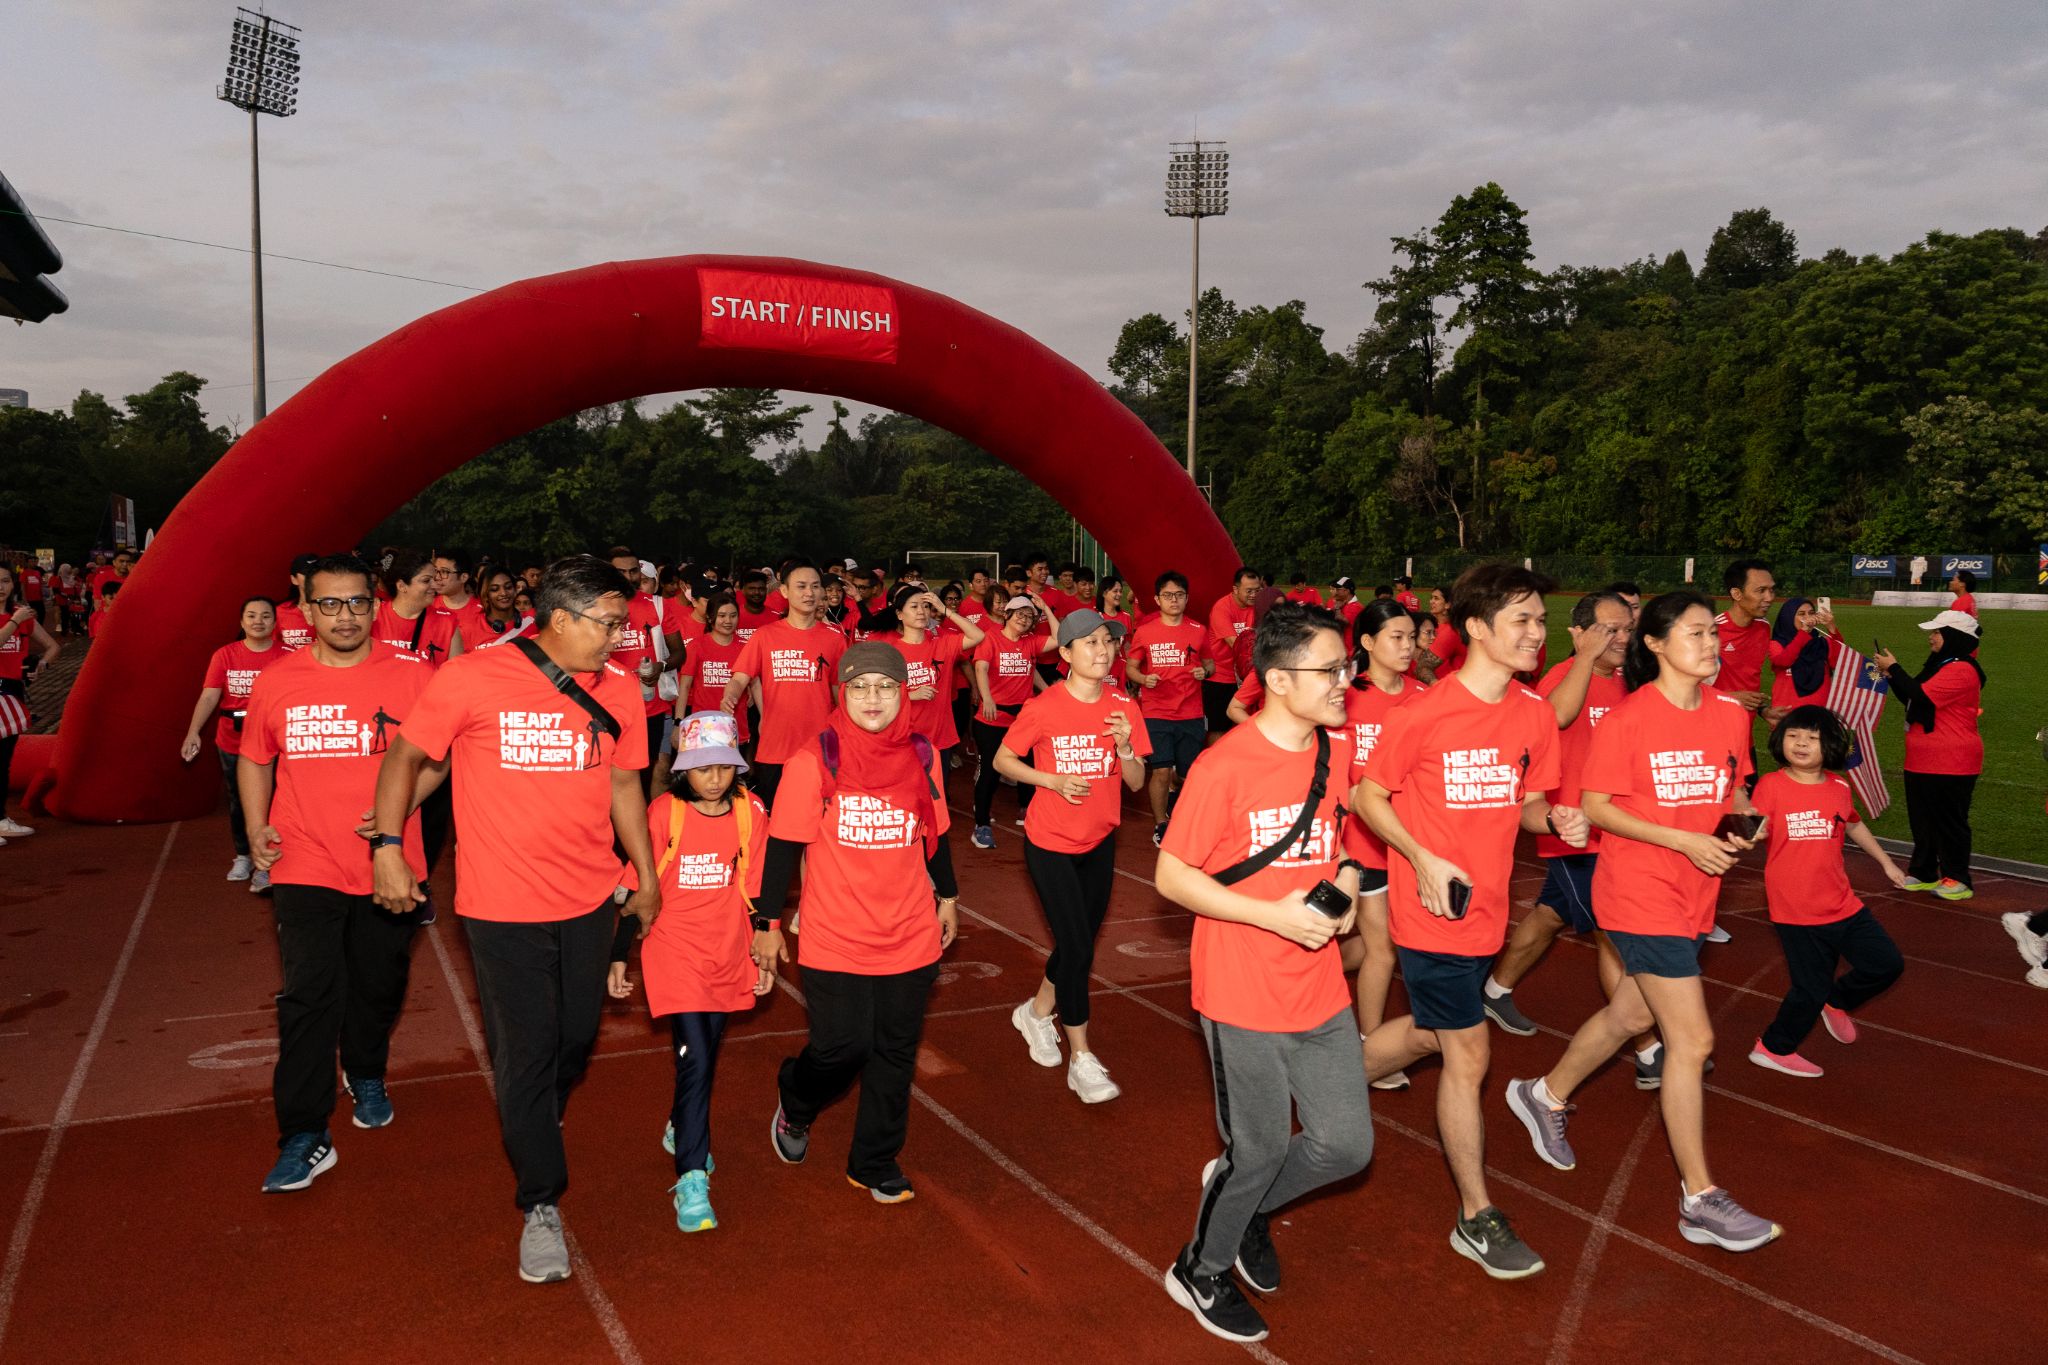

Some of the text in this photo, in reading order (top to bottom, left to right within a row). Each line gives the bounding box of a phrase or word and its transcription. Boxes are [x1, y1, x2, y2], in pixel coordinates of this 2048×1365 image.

[711, 296, 790, 324] START
[811, 306, 892, 333] FINISH
[282, 629, 308, 638] EART
[283, 636, 313, 645] EROES
[1150, 642, 1176, 650] HEART
[771, 649, 804, 659] HEART
[1151, 650, 1181, 658] HEROES
[703, 661, 728, 669] HEART
[772, 659, 809, 668] HEROES
[907, 661, 923, 670] ART
[1000, 666, 1014, 674] RUN
[227, 669, 261, 678] HEART
[773, 668, 809, 678] RUN 2024
[908, 667, 928, 678] ROES
[228, 677, 255, 686] HERO
[703, 676, 718, 684] RUN
[228, 685, 247, 695] RUN
[286, 704, 347, 722] HEART
[499, 711, 564, 729] HEART
[286, 720, 358, 737] HEROES
[1355, 723, 1382, 736] HEA
[500, 729, 573, 746] HEROES
[1051, 735, 1096, 749] HEART
[286, 736, 357, 753] RUN 2024
[500, 745, 572, 764] RUN 2024
[1053, 748, 1104, 762] HEROES
[1442, 748, 1500, 768] HEART
[1649, 750, 1704, 769] HEART
[1056, 761, 1102, 775] RUN 2024
[1444, 764, 1512, 784] HEROES
[1651, 765, 1716, 784] HEROES
[1445, 783, 1510, 802] RUN 2024
[1654, 782, 1713, 800] RUN 2024
[839, 809, 905, 827] HEROES
[1248, 802, 1305, 830] HEAR
[1785, 810, 1820, 822] HEART
[1787, 818, 1827, 830] HEROES
[838, 825, 903, 843] RUN 2024
[1788, 828, 1808, 837] RUN
[680, 853, 719, 865] HEART
[680, 863, 724, 875] HEROES
[679, 873, 724, 886] RUN 2024
